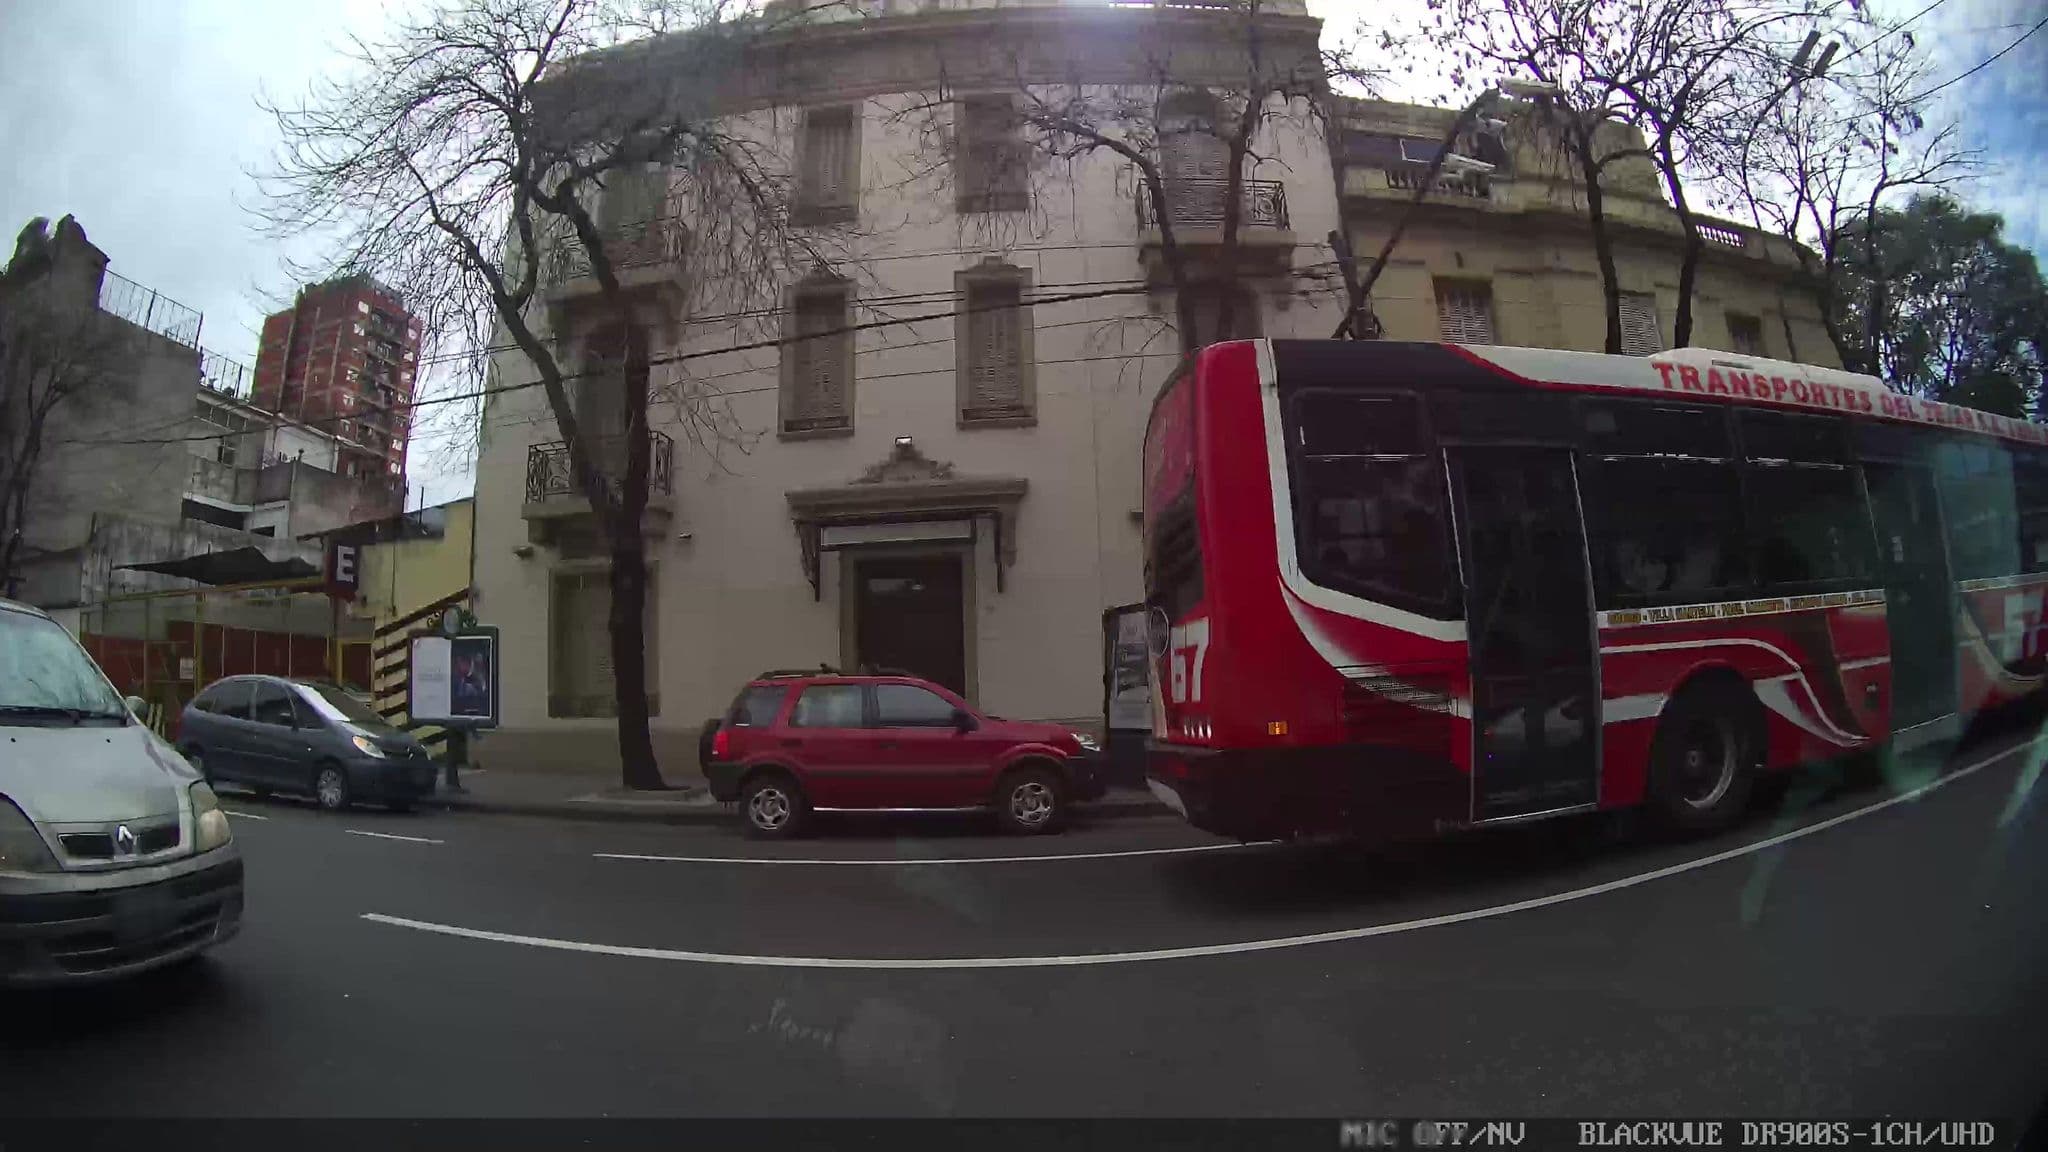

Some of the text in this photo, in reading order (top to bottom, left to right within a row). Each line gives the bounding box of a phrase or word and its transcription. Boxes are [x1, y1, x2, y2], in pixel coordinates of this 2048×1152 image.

[1652, 361, 1872, 412] TRANSPORTES
[1880, 393, 1919, 419] DEL
[336, 545, 355, 583] E
[1170, 616, 1209, 703] 67
